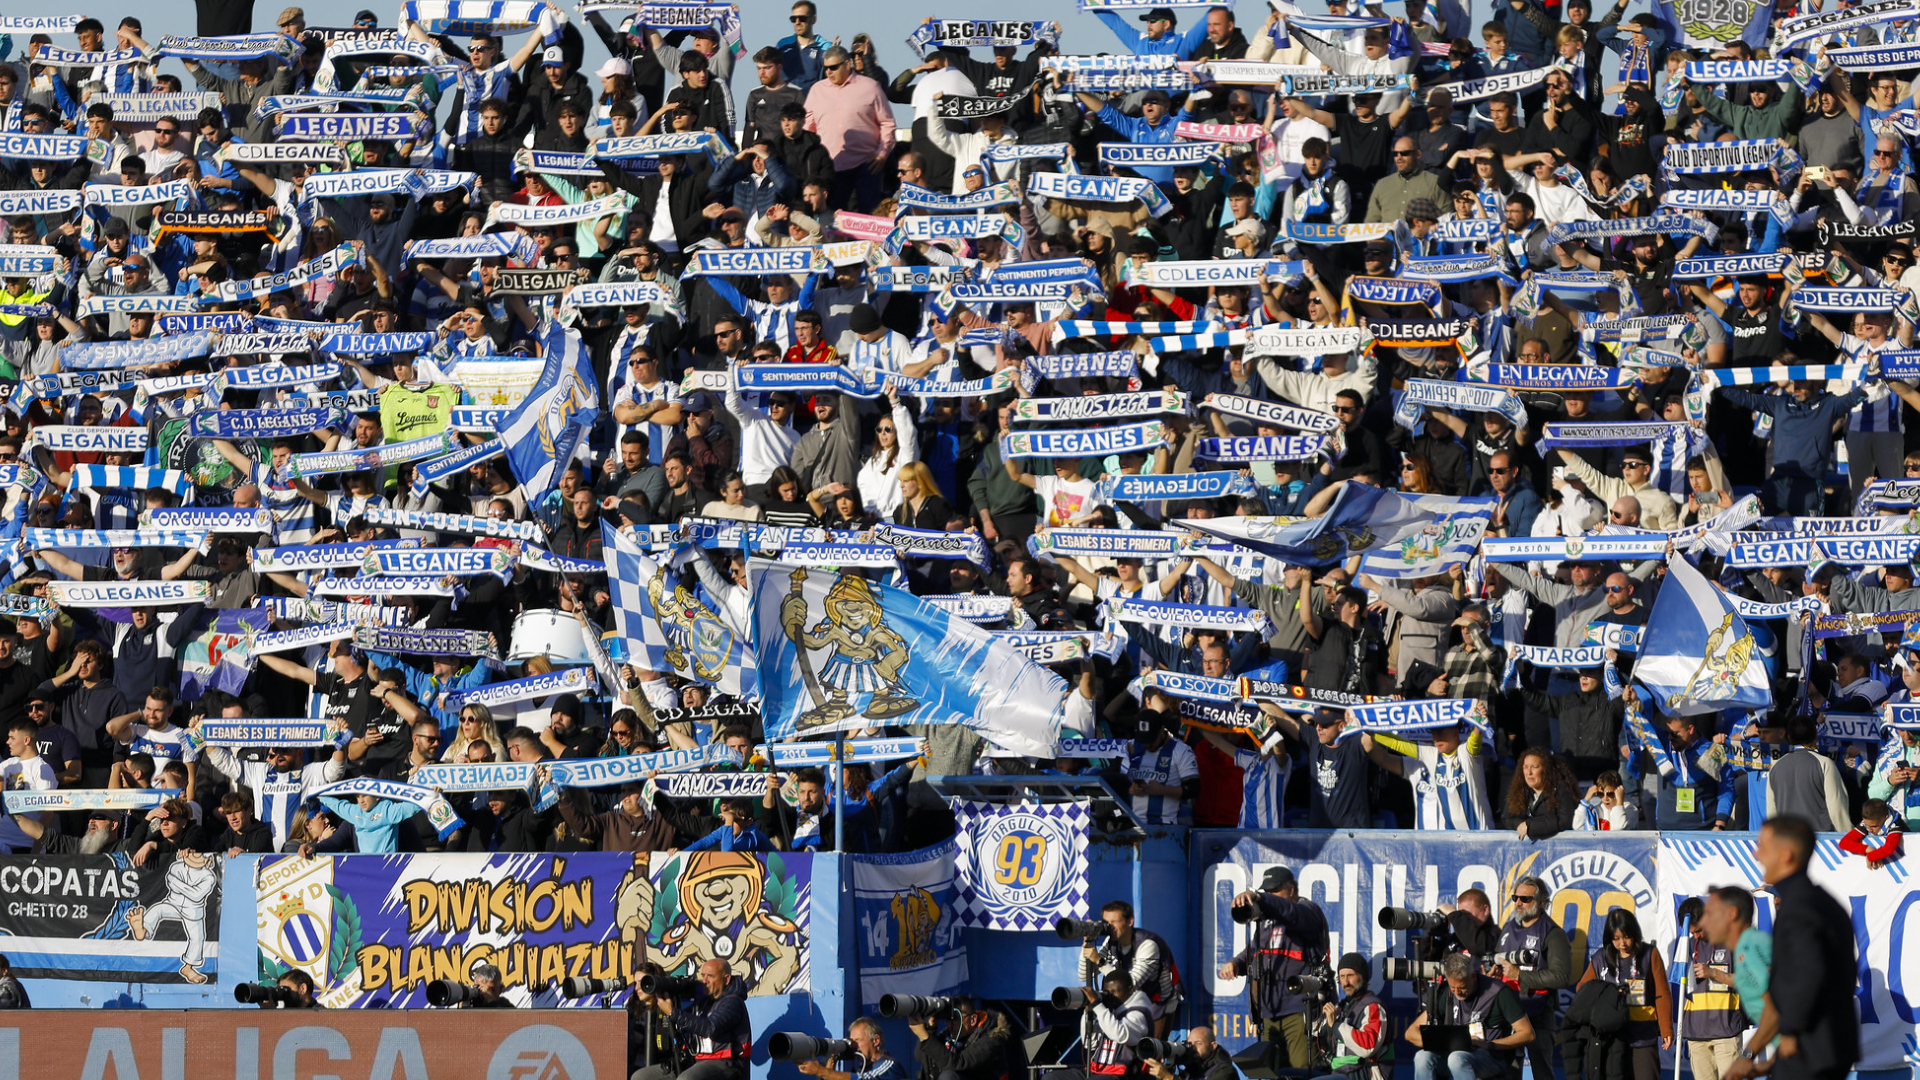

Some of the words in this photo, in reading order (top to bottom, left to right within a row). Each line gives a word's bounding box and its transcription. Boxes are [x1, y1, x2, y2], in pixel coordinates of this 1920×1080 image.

[1679, 0, 1750, 24] 1928
[1372, 74, 1398, 88] 28
[112, 101, 135, 113] C.D.
[306, 174, 400, 195] BUTARQUE
[1157, 263, 1259, 282] CDLEGANÉ
[761, 370, 819, 382] SENTIMIENTO
[1049, 396, 1105, 420] VAMOS
[1107, 393, 1150, 415] LEGA
[158, 510, 232, 526] ORGULLO
[235, 510, 252, 526] 93
[870, 524, 964, 553] Leganés
[1055, 530, 1099, 548] LEGANÉS
[1100, 535, 1112, 548] ES
[1113, 536, 1126, 549] DE
[1128, 537, 1172, 551] PRIMERA
[1731, 543, 1808, 562] LEGAN
[68, 582, 184, 601] CDLEGANÉS
[1126, 602, 1144, 617] TE
[1147, 605, 1204, 624] QUIERO
[1207, 609, 1246, 625] LEGA
[473, 684, 523, 701] QUIERO
[524, 677, 560, 694] LEGA
[1160, 675, 1183, 689] YO
[1184, 678, 1214, 694] SOY
[206, 724, 249, 740] LEGANÉS
[250, 727, 263, 740] ES
[265, 727, 279, 740] DE
[280, 726, 321, 741] PRIMERA
[781, 749, 809, 760] 2014
[870, 743, 900, 756] 2024
[668, 774, 725, 796] VAMOS
[992, 817, 1056, 843] ORGULLO
[994, 834, 1047, 886] 93
[404, 856, 594, 933] DIVISIÓN
[1001, 886, 1038, 903] 2010
[8, 901, 68, 919] GHETTO
[71, 903, 89, 919] 28
[357, 940, 637, 994] BLANQUIAZUL
